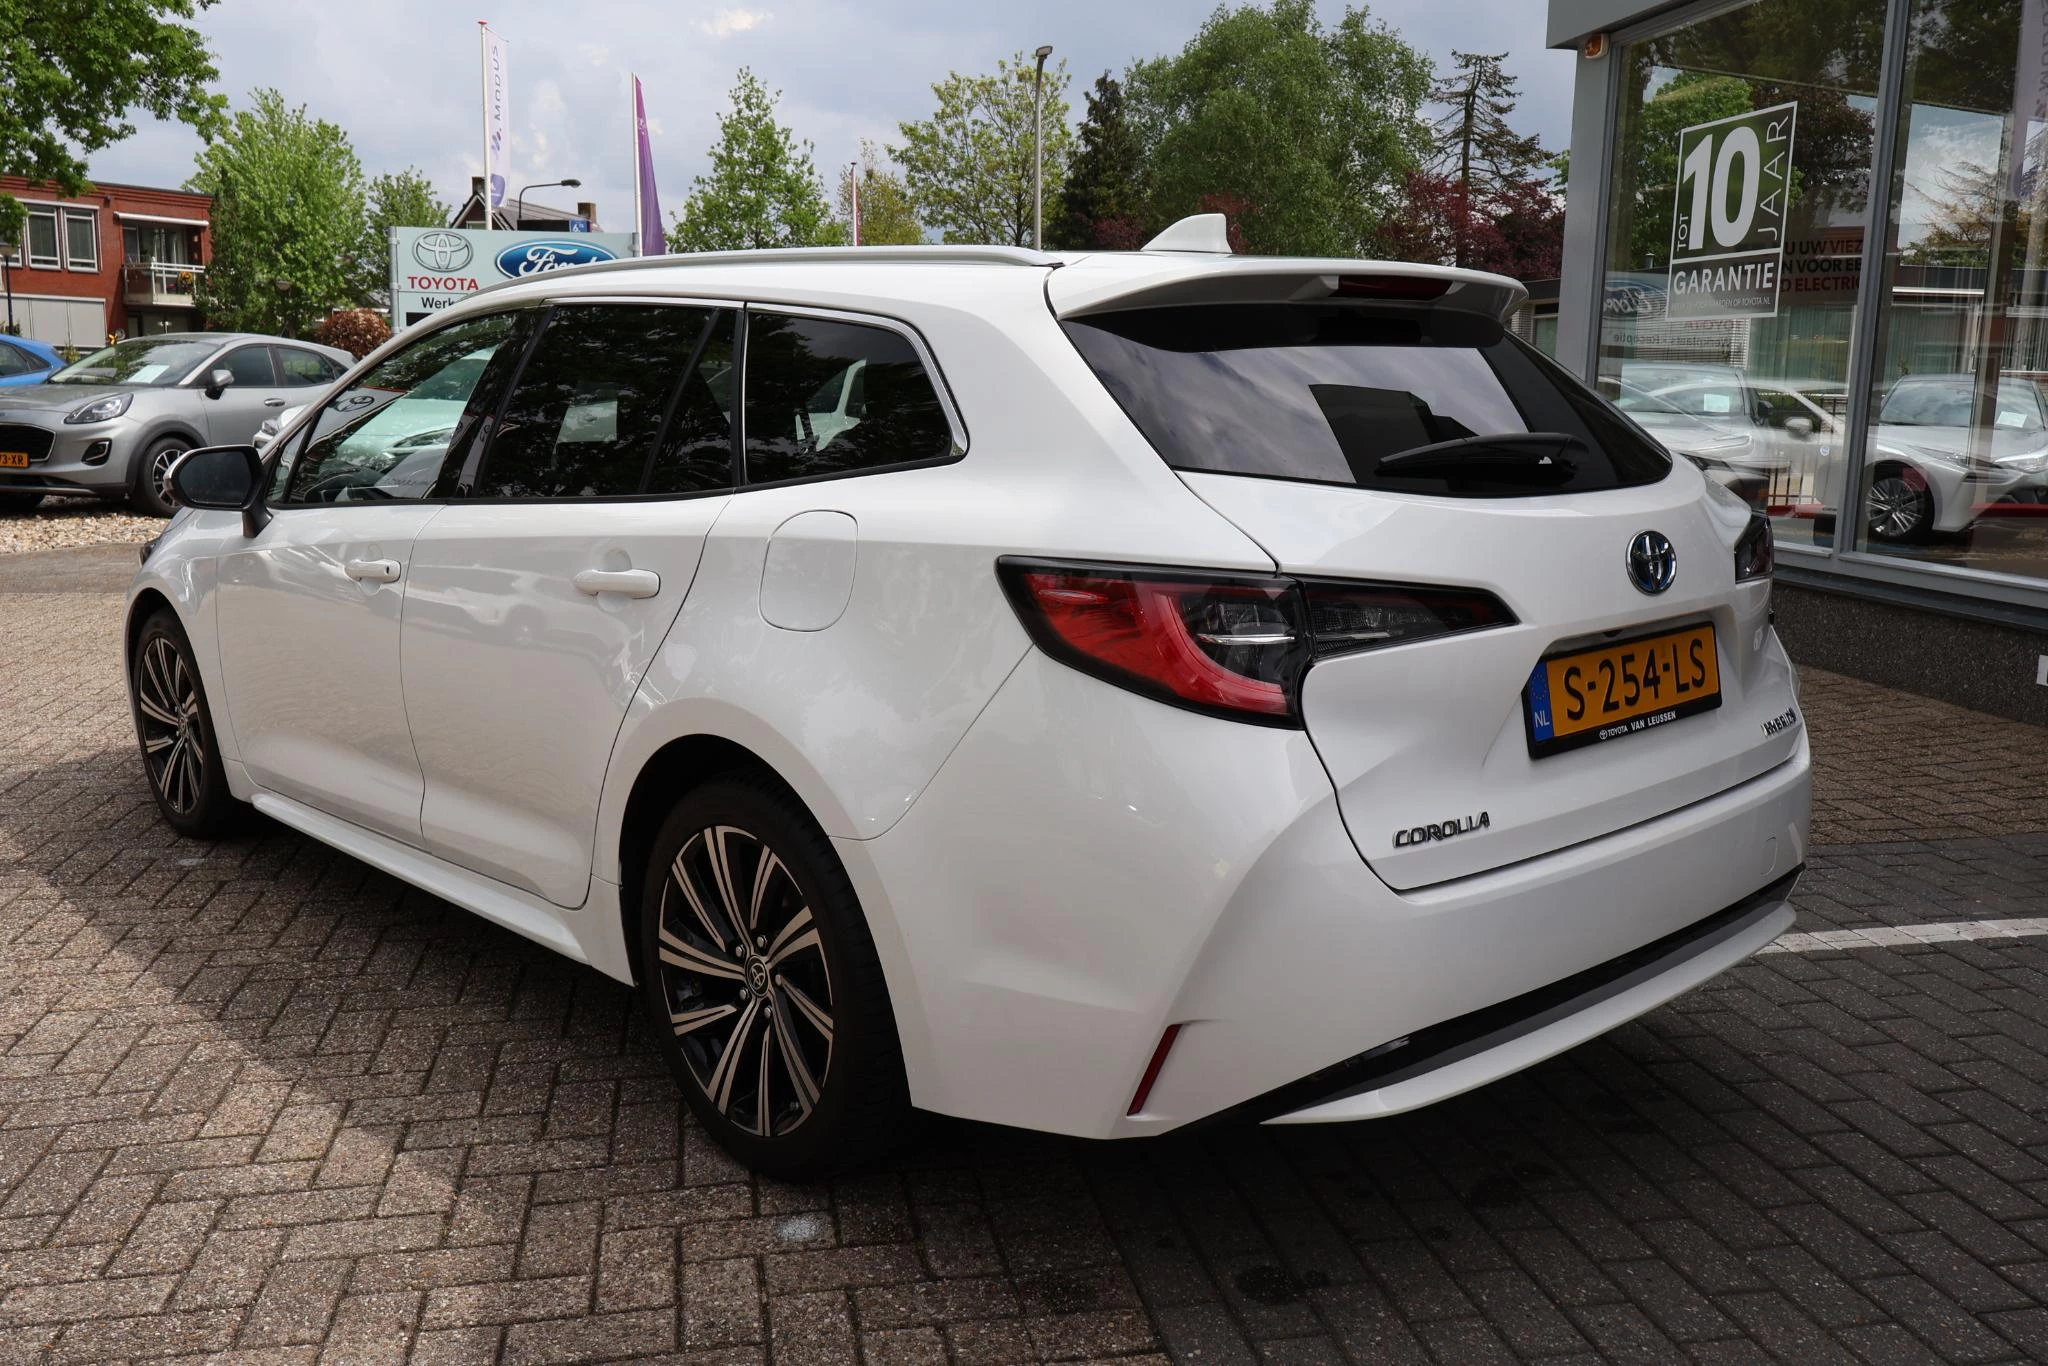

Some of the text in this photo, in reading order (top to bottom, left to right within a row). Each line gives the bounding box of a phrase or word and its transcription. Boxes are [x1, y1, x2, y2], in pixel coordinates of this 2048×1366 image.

[492, 45, 502, 121] MODUS
[1682, 126, 1760, 250] 10
[1757, 115, 1789, 240] JAAR
[1677, 213, 1689, 251] TOT
[1800, 240, 1825, 255] UW
[519, 246, 598, 277] For
[1673, 261, 1775, 297] GARANTIE
[1796, 258, 1842, 273] VOOR
[407, 276, 479, 291] TOYOTA
[1563, 638, 1706, 721] S-254-LS
[1534, 710, 1550, 729] NL
[1607, 710, 1676, 738] TOYOTA VAN LEUSSEN
[1391, 811, 1490, 848] COROLLA
